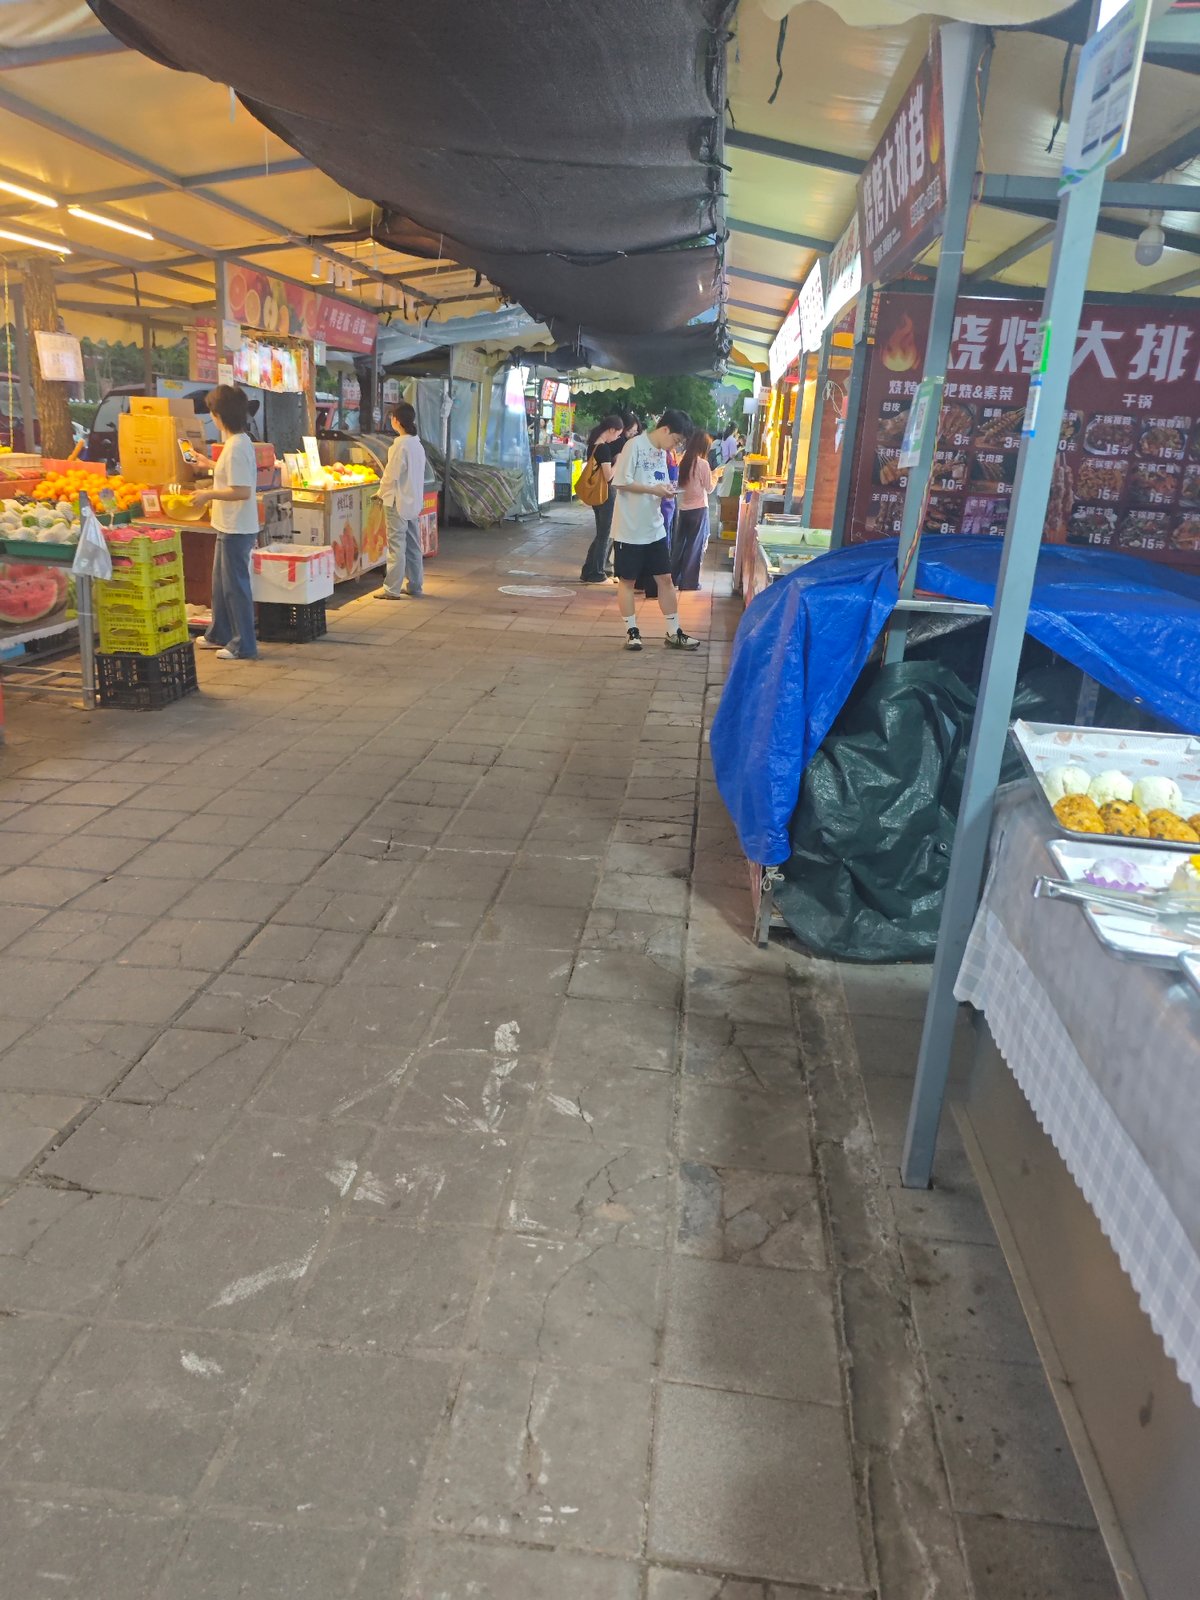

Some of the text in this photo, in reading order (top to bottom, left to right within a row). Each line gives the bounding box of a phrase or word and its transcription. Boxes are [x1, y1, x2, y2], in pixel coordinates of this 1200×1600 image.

[947, 314, 1200, 383] 烧烤大排
[1122, 393, 1154, 409] 干锅
[953, 433, 970, 446] 3元
[1003, 436, 1020, 449] 3元
[1106, 443, 1129, 455] 15元
[1158, 447, 1181, 459] 15元
[942, 479, 963, 491] 10元
[997, 482, 1013, 494] 8元
[1097, 488, 1119, 501] 15元
[1149, 492, 1172, 504] 15元
[940, 523, 956, 534] 8元
[989, 525, 1005, 537] 2元
[1088, 533, 1111, 545] 15元
[1142, 538, 1165, 550] 15元
